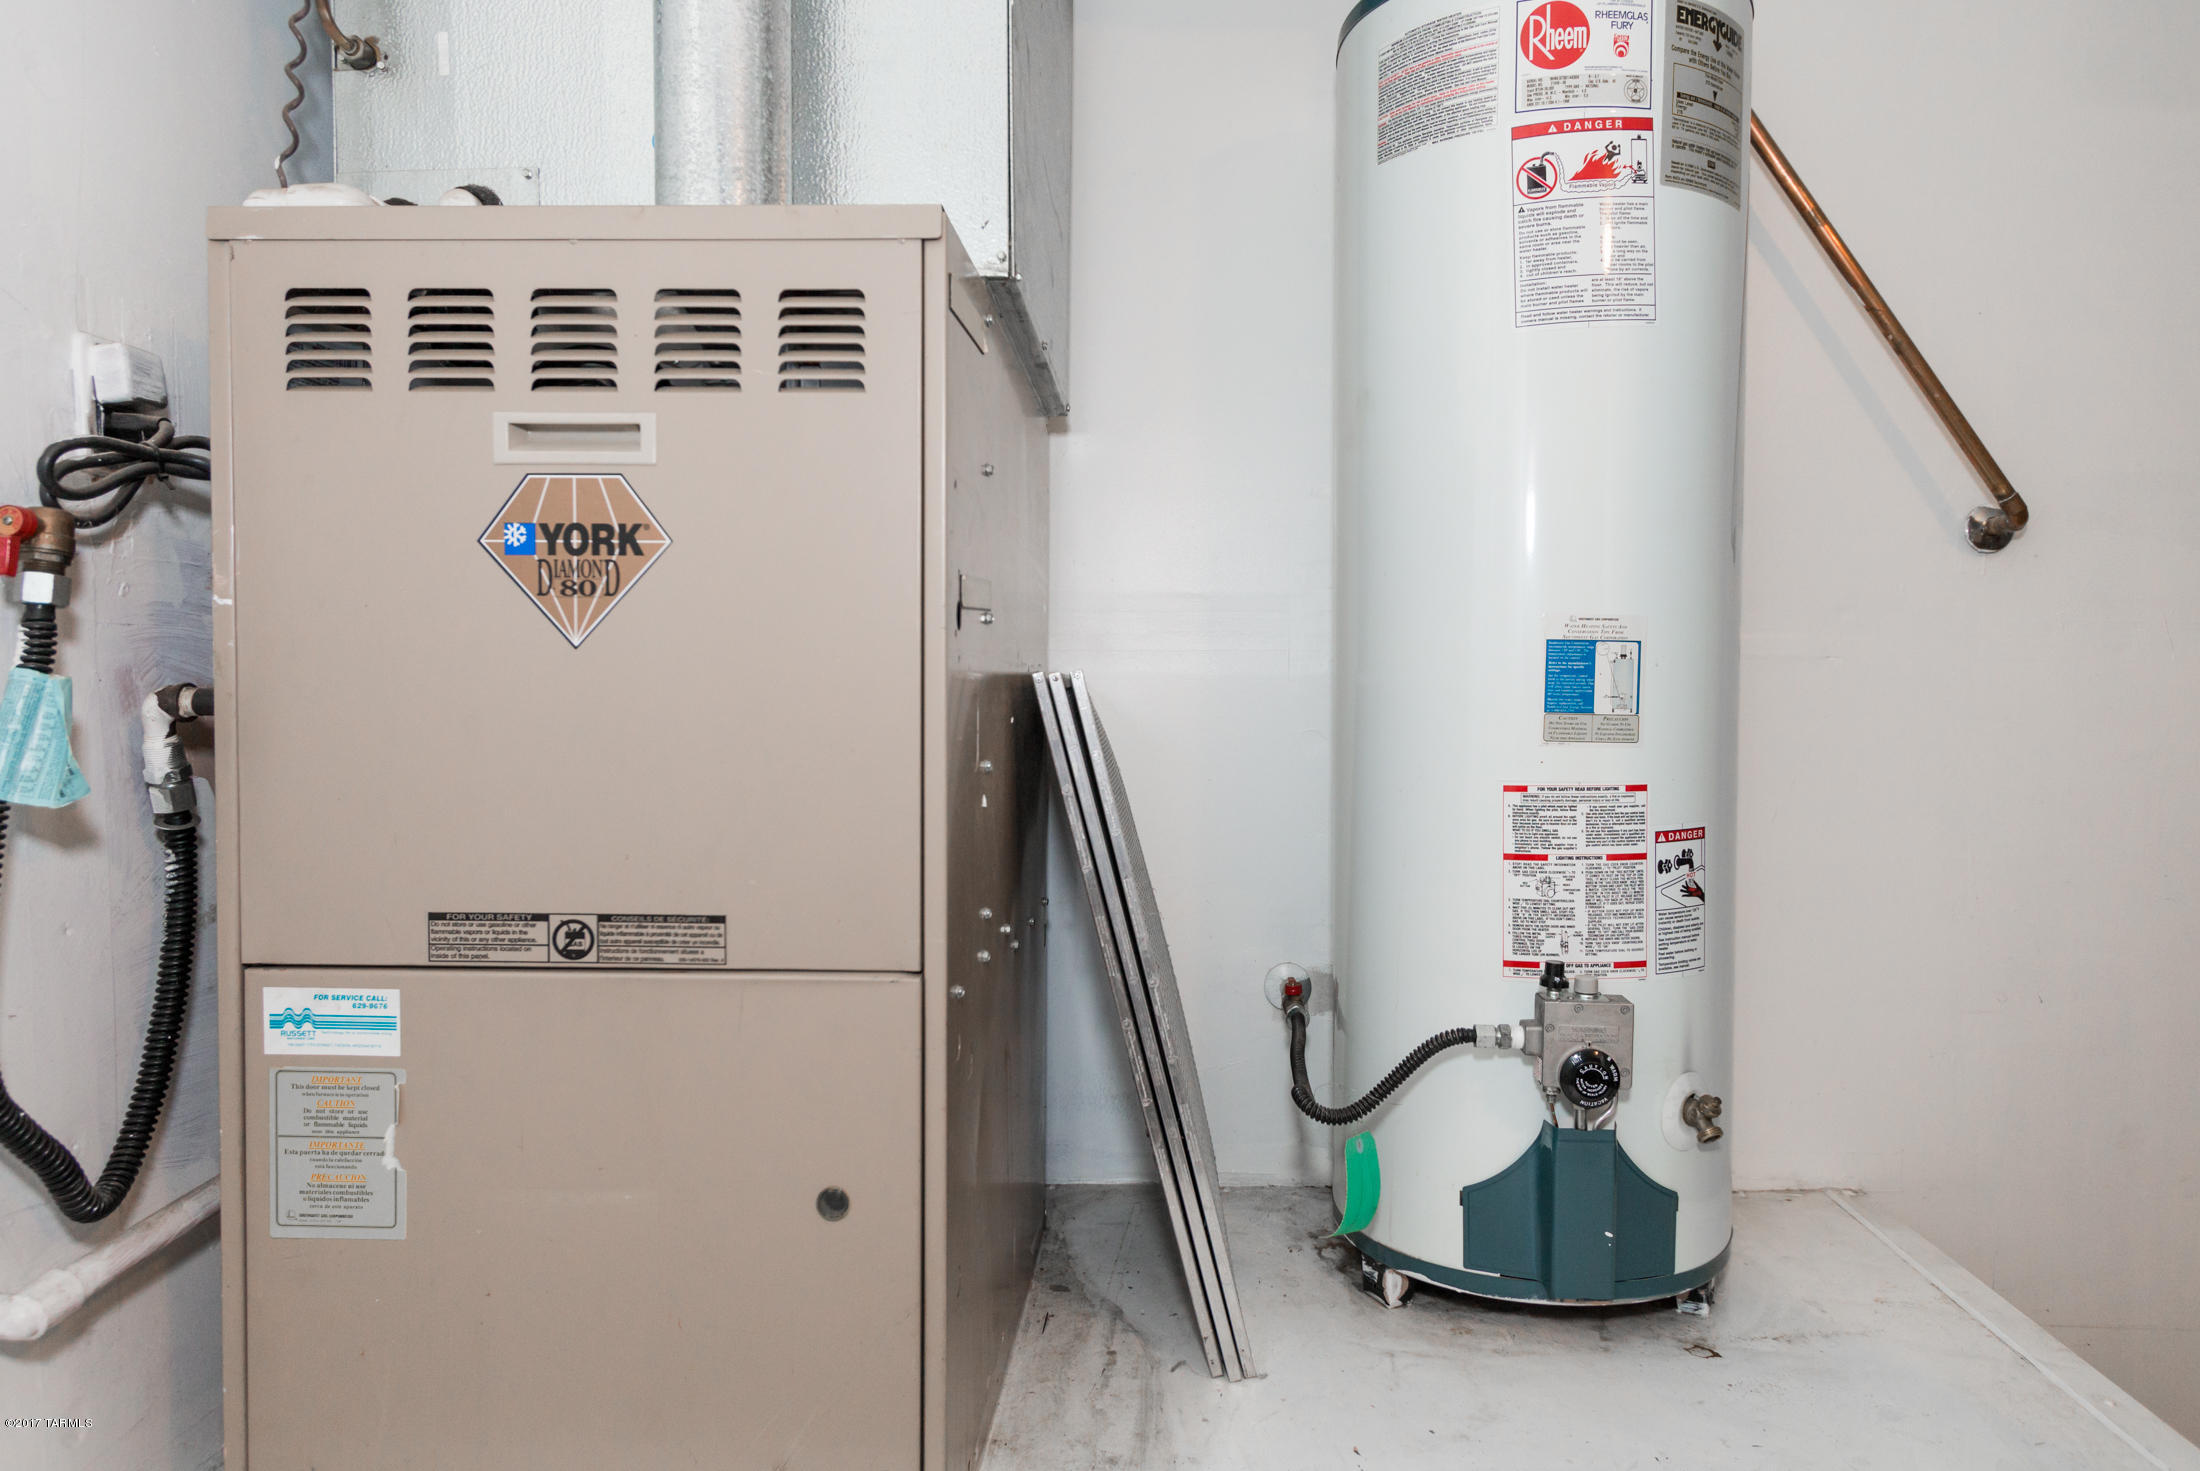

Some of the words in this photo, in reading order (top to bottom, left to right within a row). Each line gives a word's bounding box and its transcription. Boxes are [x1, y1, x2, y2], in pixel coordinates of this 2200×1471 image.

[1528, 4, 1588, 60] Rheem
[1611, 20, 1634, 30] FURY
[1676, 5, 1742, 52] ENERGYGUIDE
[1672, 44, 1690, 54] Compare
[1698, 51, 1710, 62] Energy
[1564, 120, 1623, 131] DANGER
[539, 522, 644, 556] YORK
[537, 559, 620, 596] DIAMOND
[560, 580, 597, 597] 80
[1668, 828, 1704, 841] DANGER
[312, 1075, 362, 1084] IMPORTANT
[1579, 1064, 1609, 1080] CAUTION
[1610, 1064, 1618, 1082] WARM
[1580, 1097, 1608, 1106] VACATION
[309, 1140, 367, 1149] IMPORTANTE
